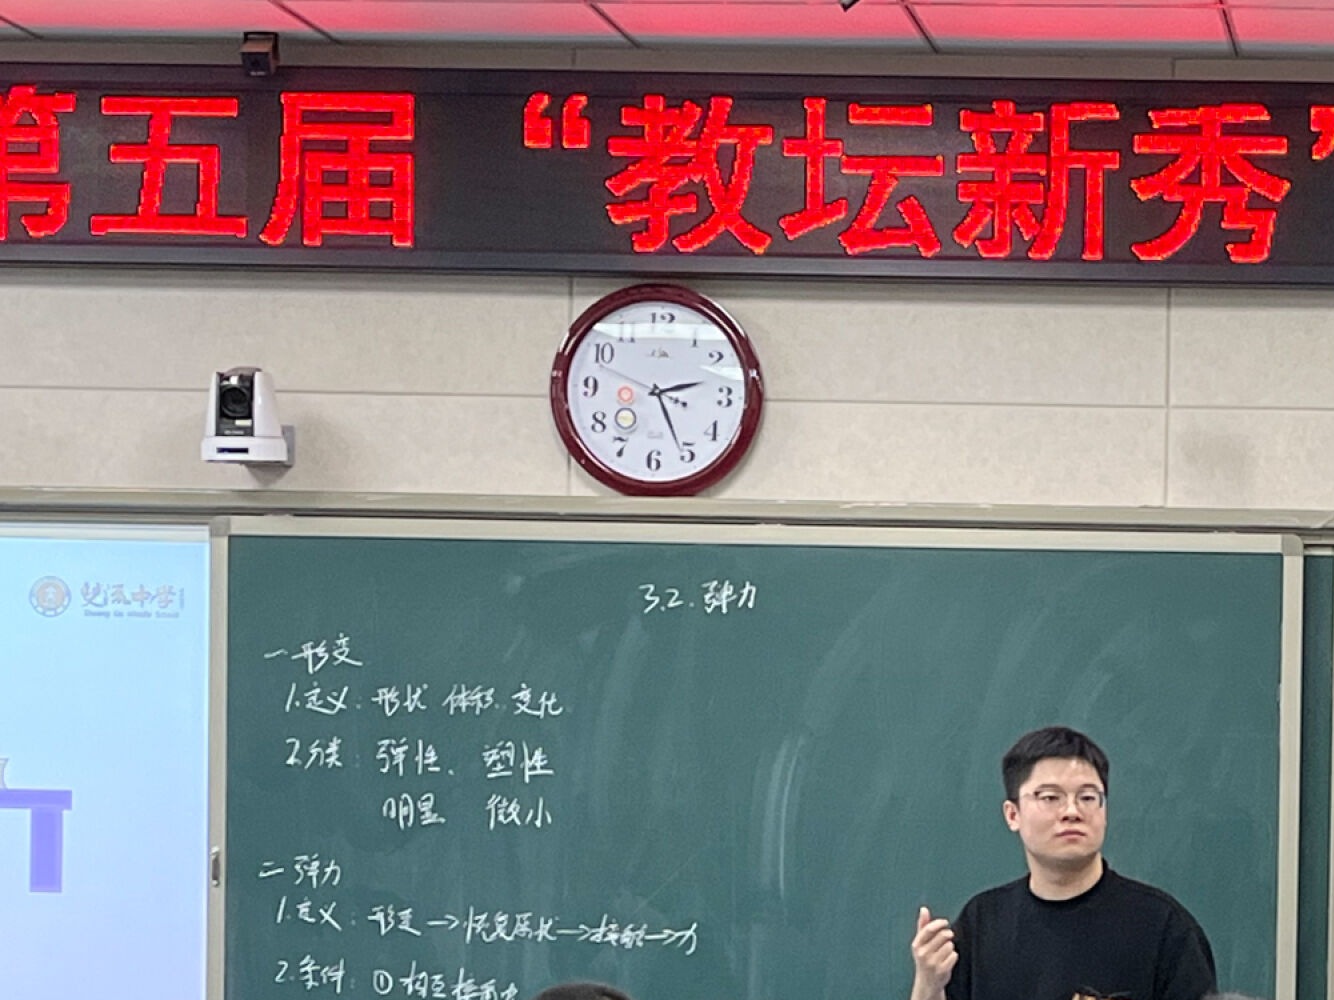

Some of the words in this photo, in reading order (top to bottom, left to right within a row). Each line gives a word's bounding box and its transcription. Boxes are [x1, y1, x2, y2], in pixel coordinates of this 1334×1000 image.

[651, 312, 676, 333] 12
[594, 343, 615, 363] 10
[708, 351, 724, 368] 2
[583, 376, 598, 397] 9
[717, 386, 733, 408] 3
[591, 411, 607, 433] 8
[704, 420, 720, 441] 4
[613, 436, 629, 458] 7
[680, 441, 696, 463] 5
[646, 450, 661, 471] 6
